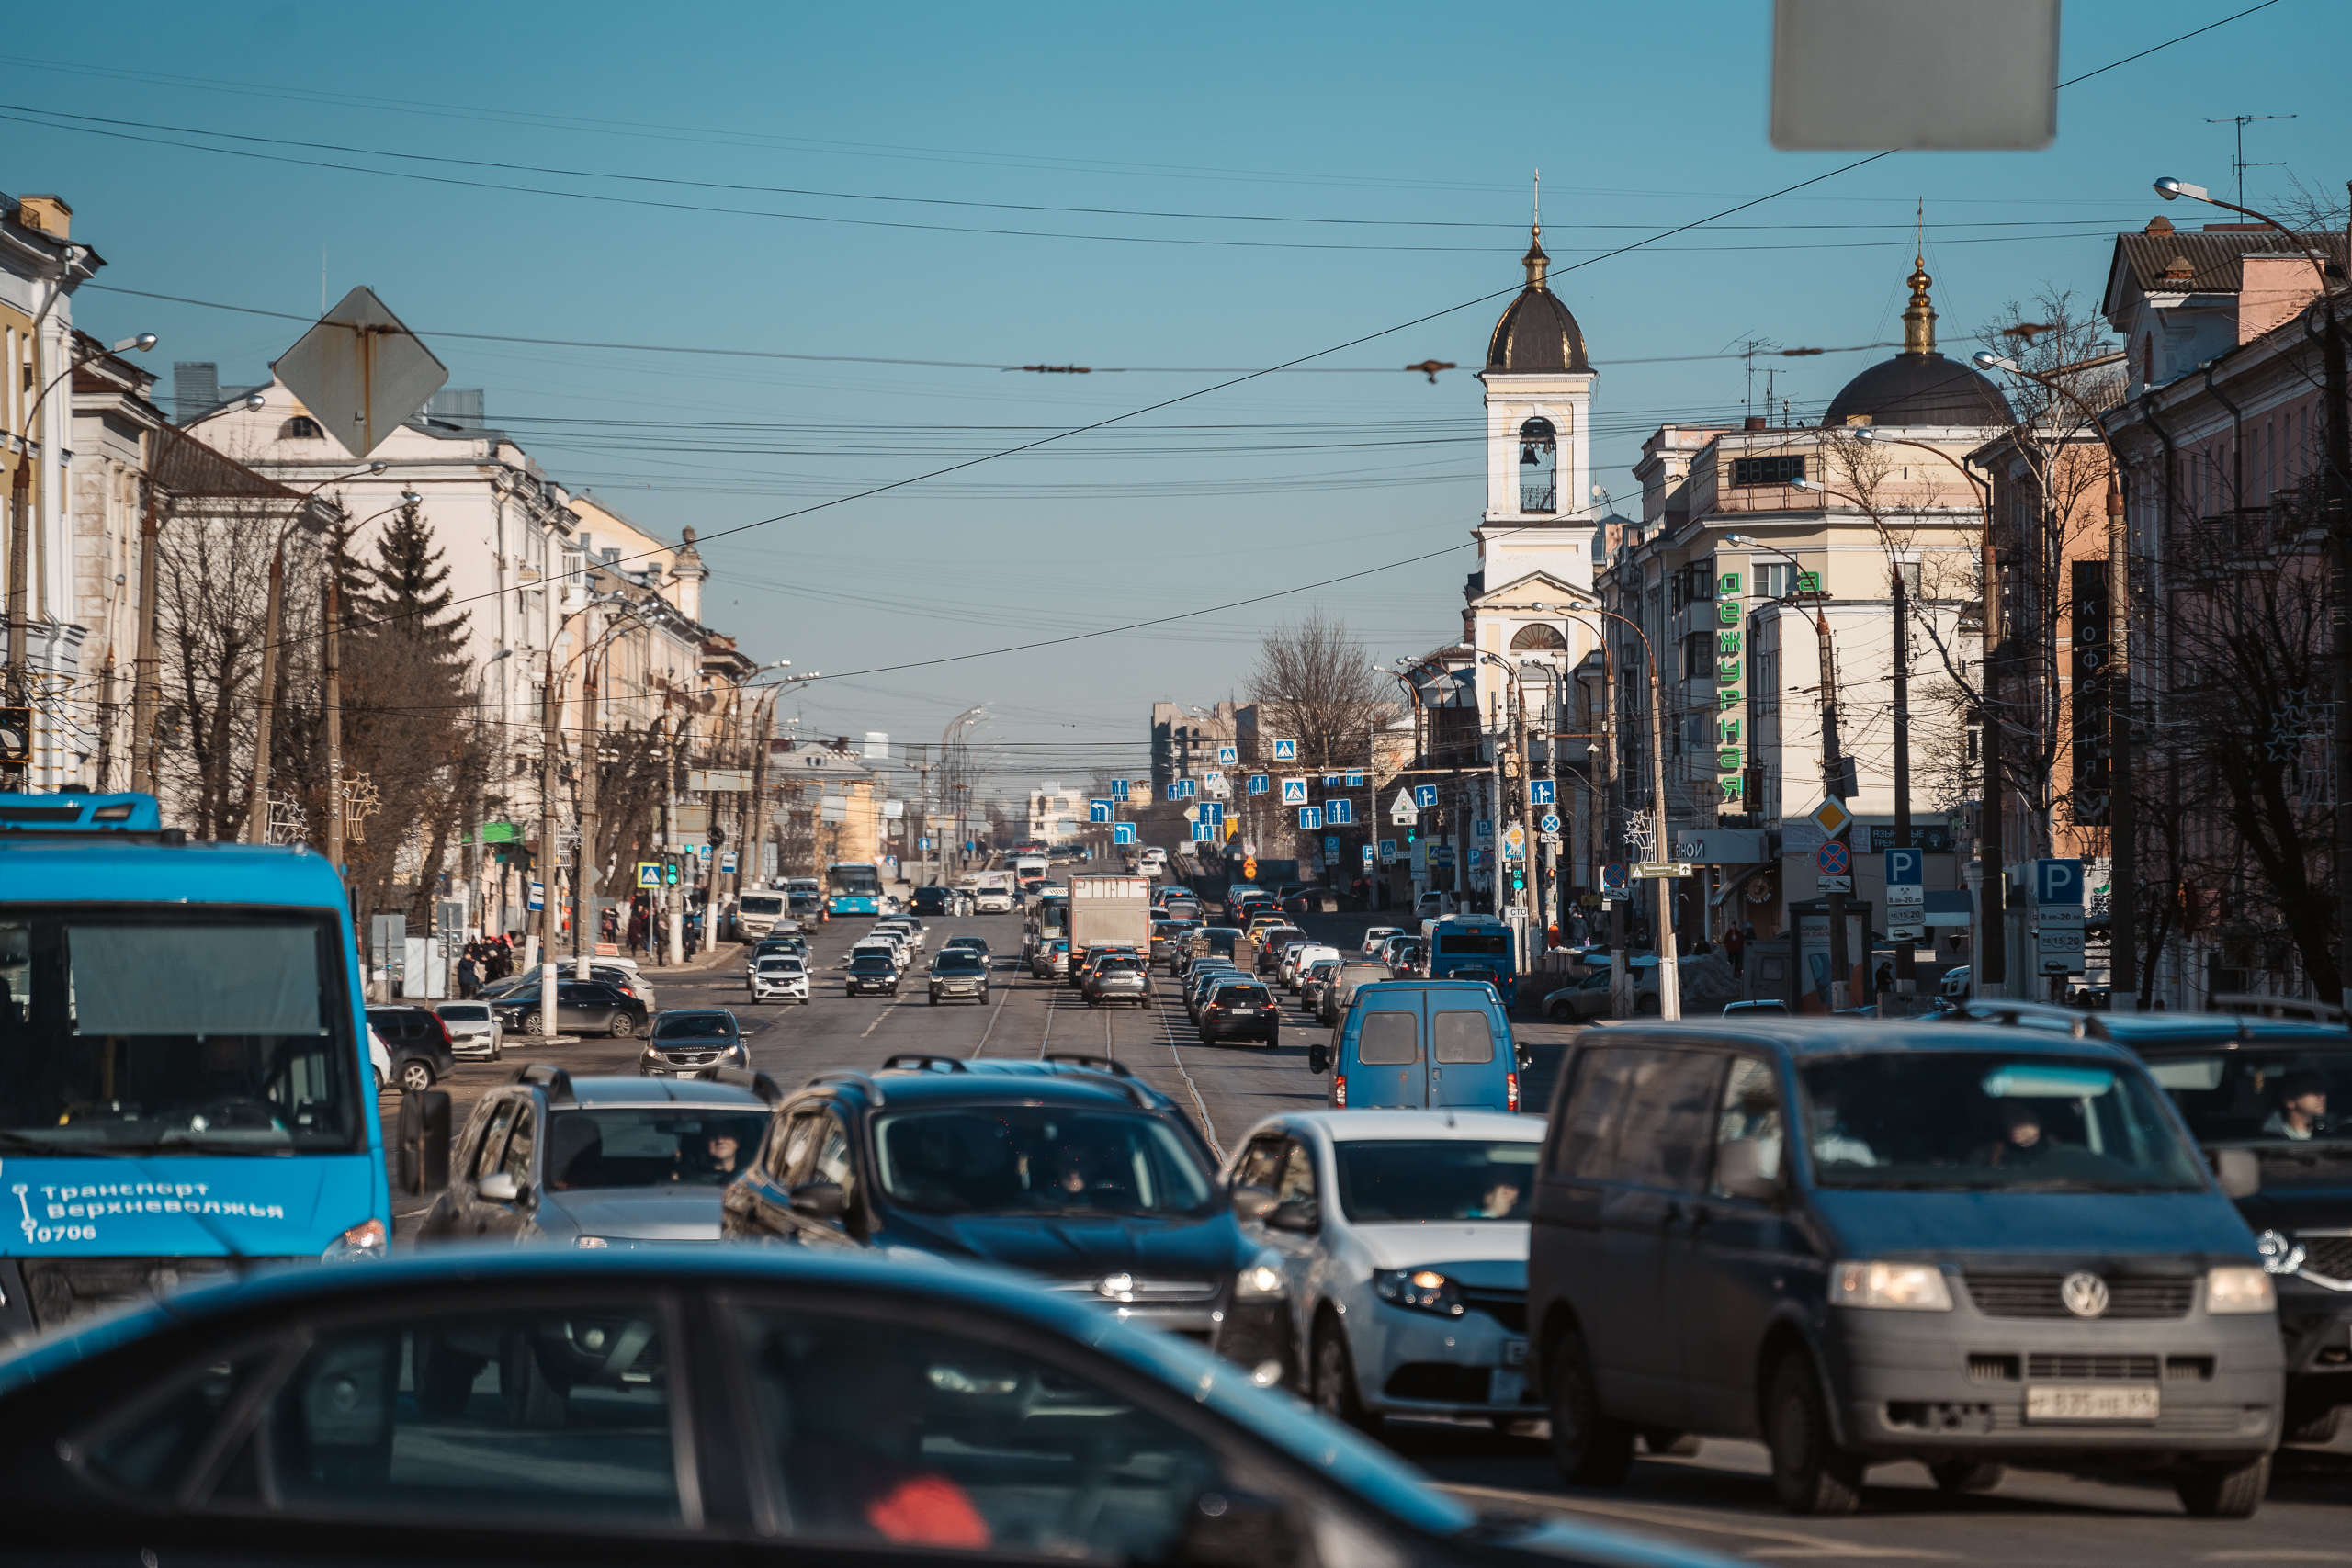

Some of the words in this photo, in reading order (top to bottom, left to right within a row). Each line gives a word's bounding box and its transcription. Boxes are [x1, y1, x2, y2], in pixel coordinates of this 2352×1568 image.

[1910, 910, 1921, 919] 20
[2053, 936, 2064, 945] 15
[2066, 936, 2080, 946] 20
[40, 1182, 209, 1202] Транспорт
[47, 1199, 284, 1220] Верхневолжья
